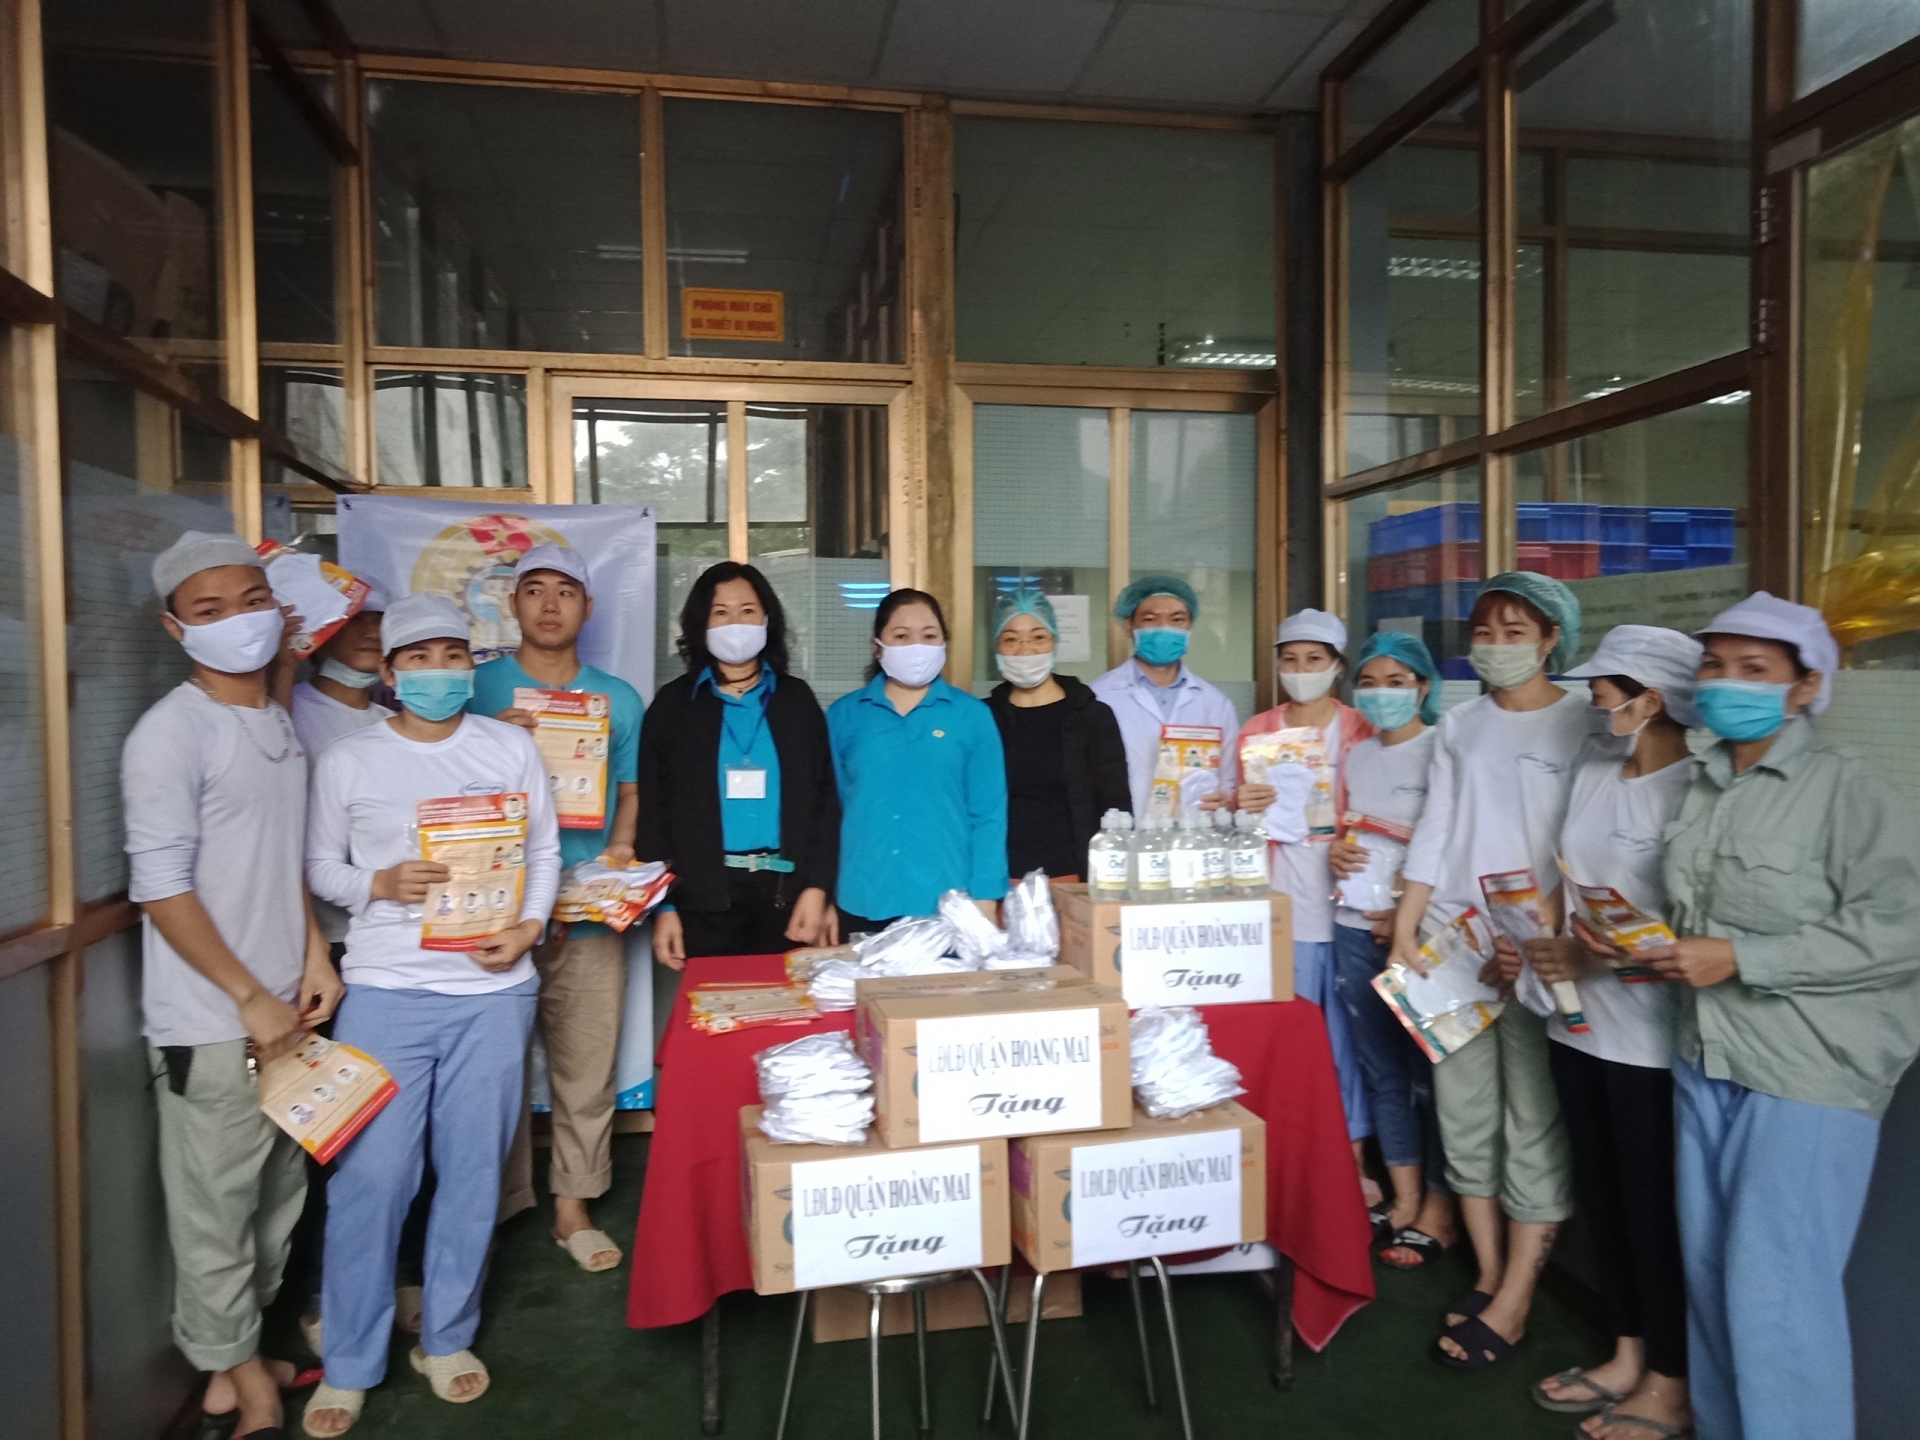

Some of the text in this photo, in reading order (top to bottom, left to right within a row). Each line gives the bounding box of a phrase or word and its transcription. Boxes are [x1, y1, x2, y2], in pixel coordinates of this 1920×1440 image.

[1163, 919, 1198, 954] QUẬN
[1199, 917, 1238, 948] HOÀNG
[1239, 921, 1263, 946] MAI
[1162, 968, 1244, 991] Tặng
[968, 1035, 1007, 1076] QUẬN
[1010, 1031, 1060, 1068] HOÀNG
[1064, 1035, 1091, 1063] MAI
[968, 1093, 1067, 1119] Tặng
[1119, 1157, 1157, 1200] QUẬN
[1158, 1152, 1205, 1191] HOÀNG
[1207, 1154, 1234, 1183] MAI
[845, 1174, 887, 1219] QUẬN
[888, 1170, 940, 1209] HOÀNG
[942, 1172, 971, 1203] MAI
[1117, 1214, 1211, 1239] Tặng
[844, 1234, 947, 1260] Tặng
